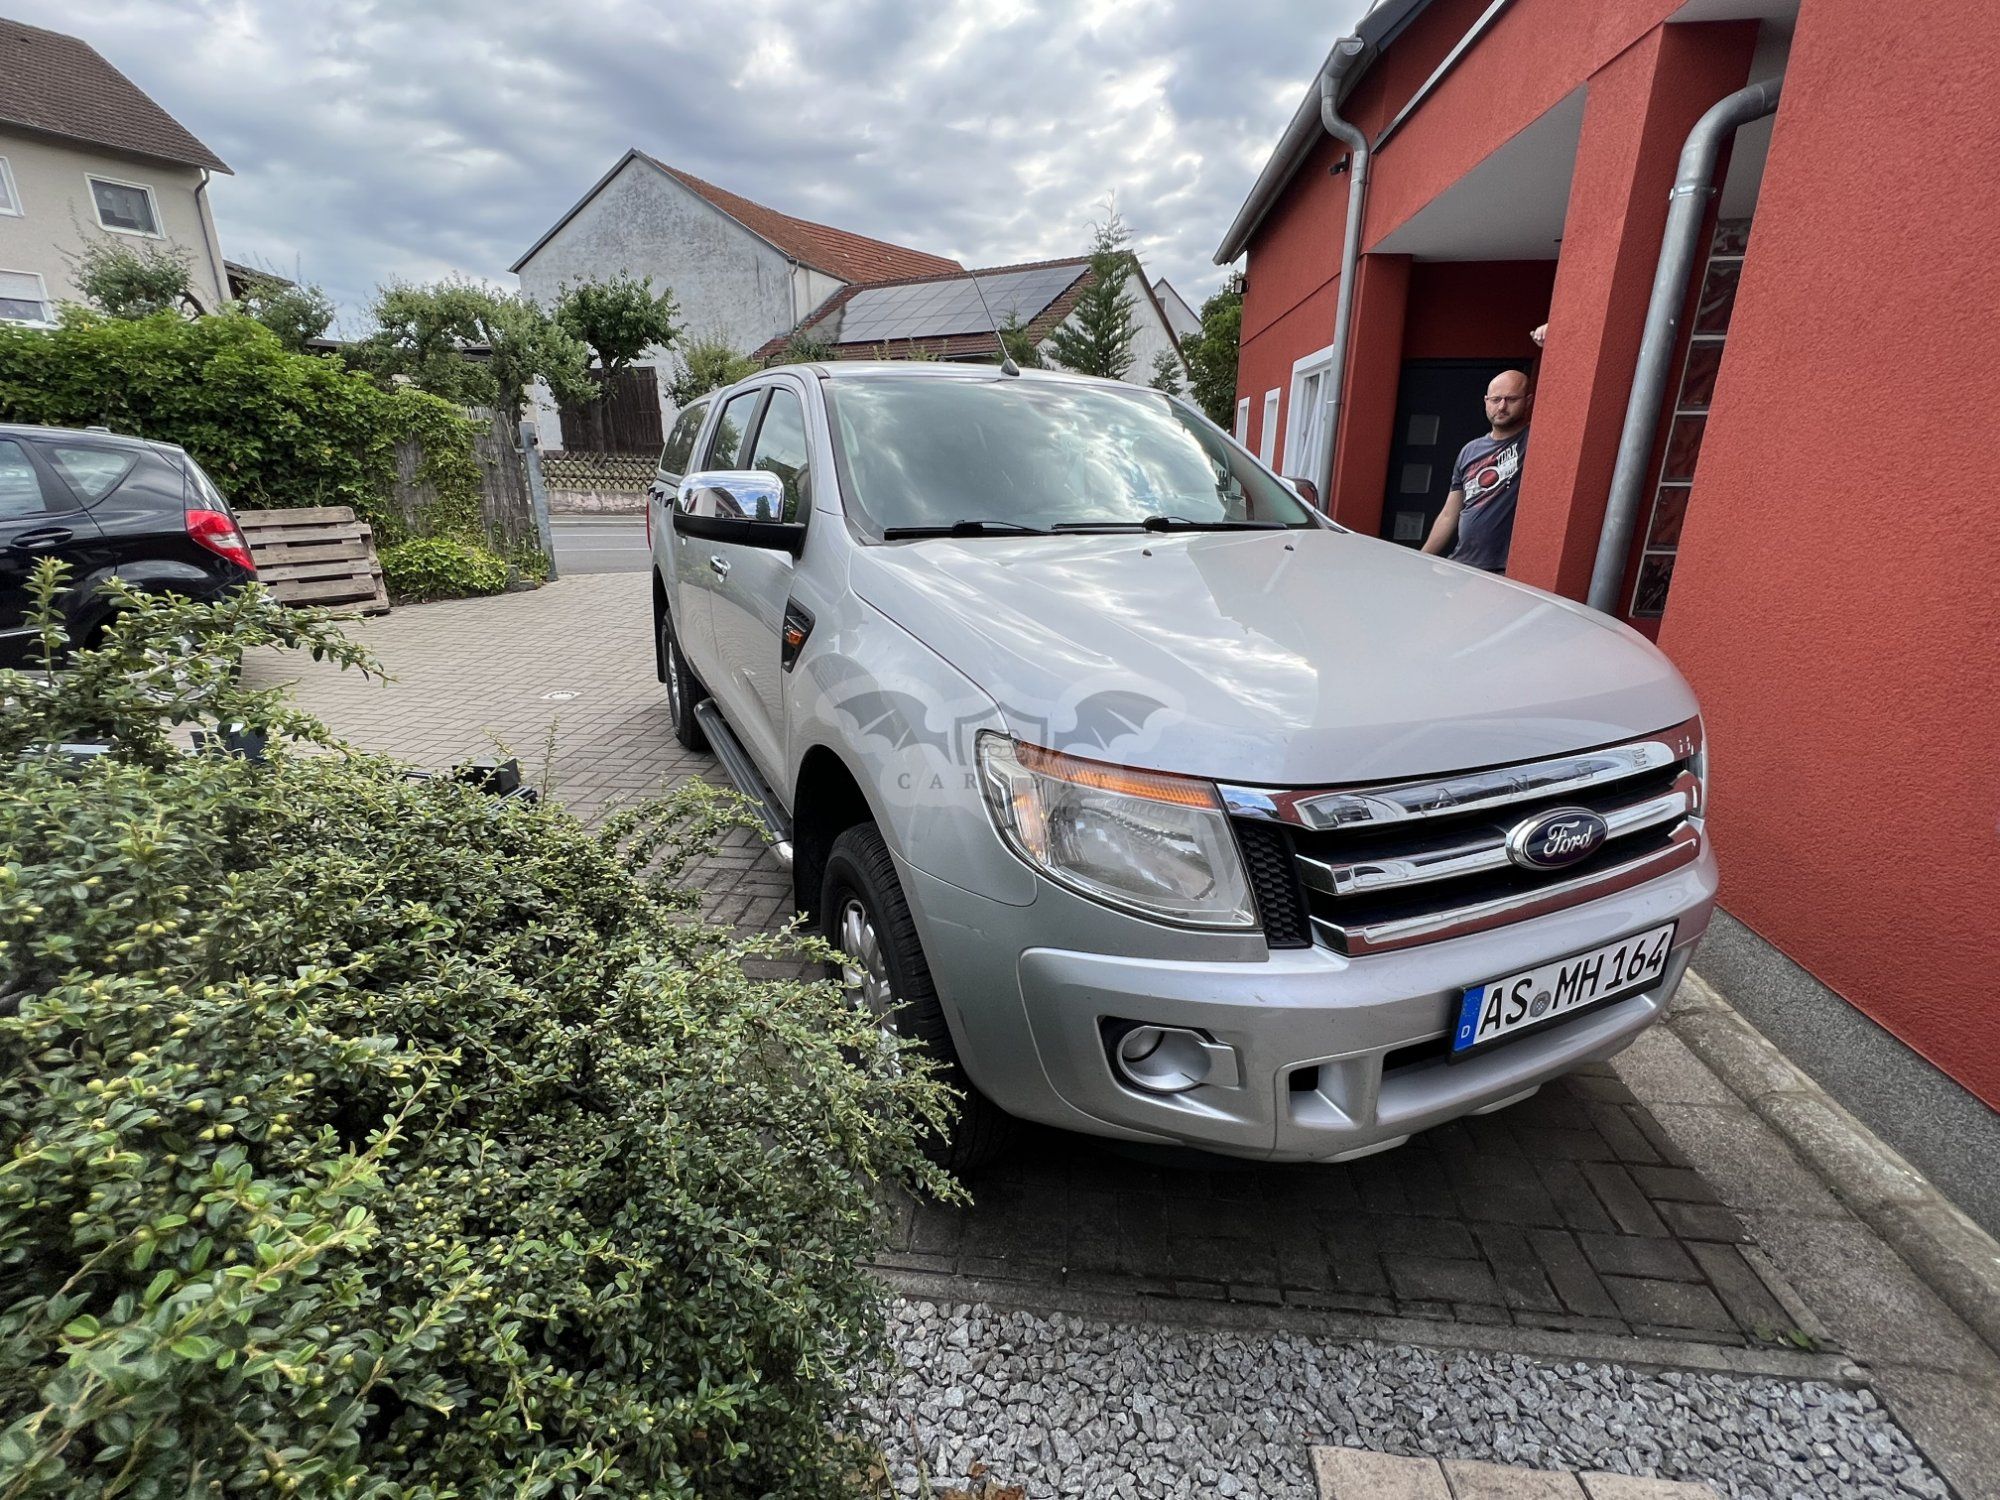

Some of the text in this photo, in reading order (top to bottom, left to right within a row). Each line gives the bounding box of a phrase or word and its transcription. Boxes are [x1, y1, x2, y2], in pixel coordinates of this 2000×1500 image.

[1543, 820, 1593, 858] Ford
[1479, 930, 1669, 1035] AS MH 164
[1461, 1025, 1470, 1038] D
